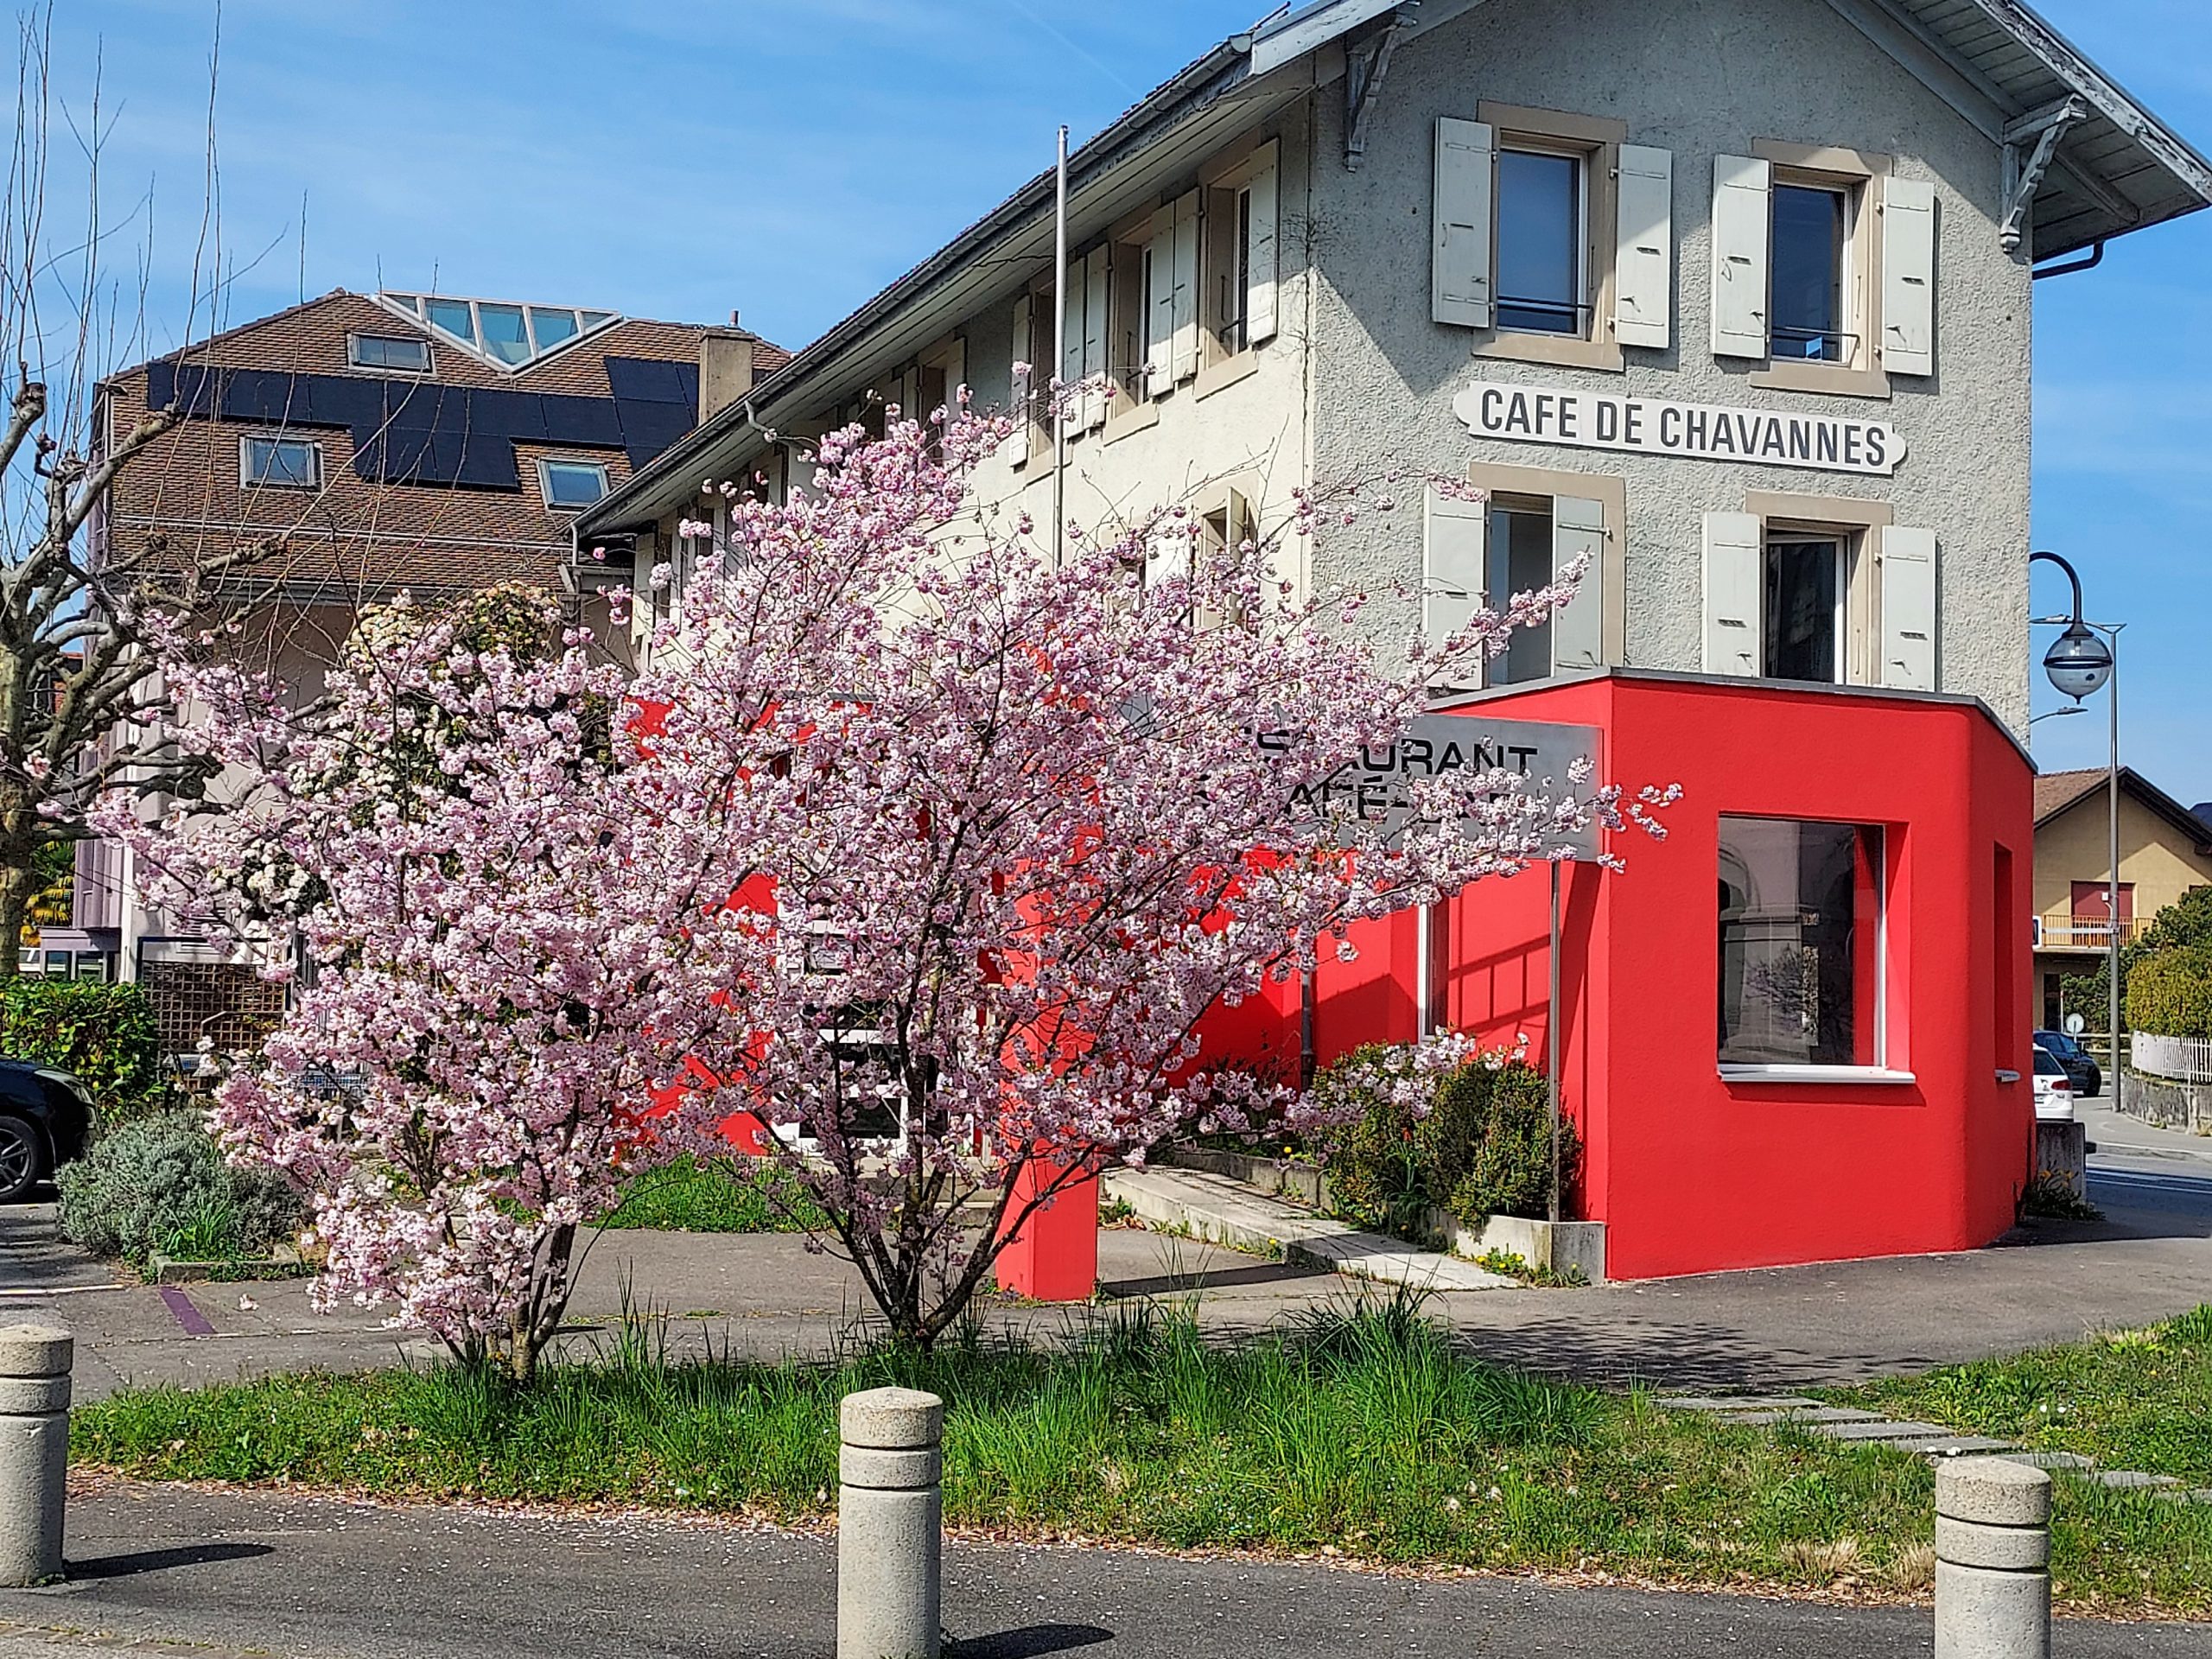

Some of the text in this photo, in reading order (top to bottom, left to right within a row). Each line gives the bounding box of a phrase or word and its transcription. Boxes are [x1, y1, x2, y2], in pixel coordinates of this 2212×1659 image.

[1480, 389, 1886, 467] CAFE DE CHAVANNES
